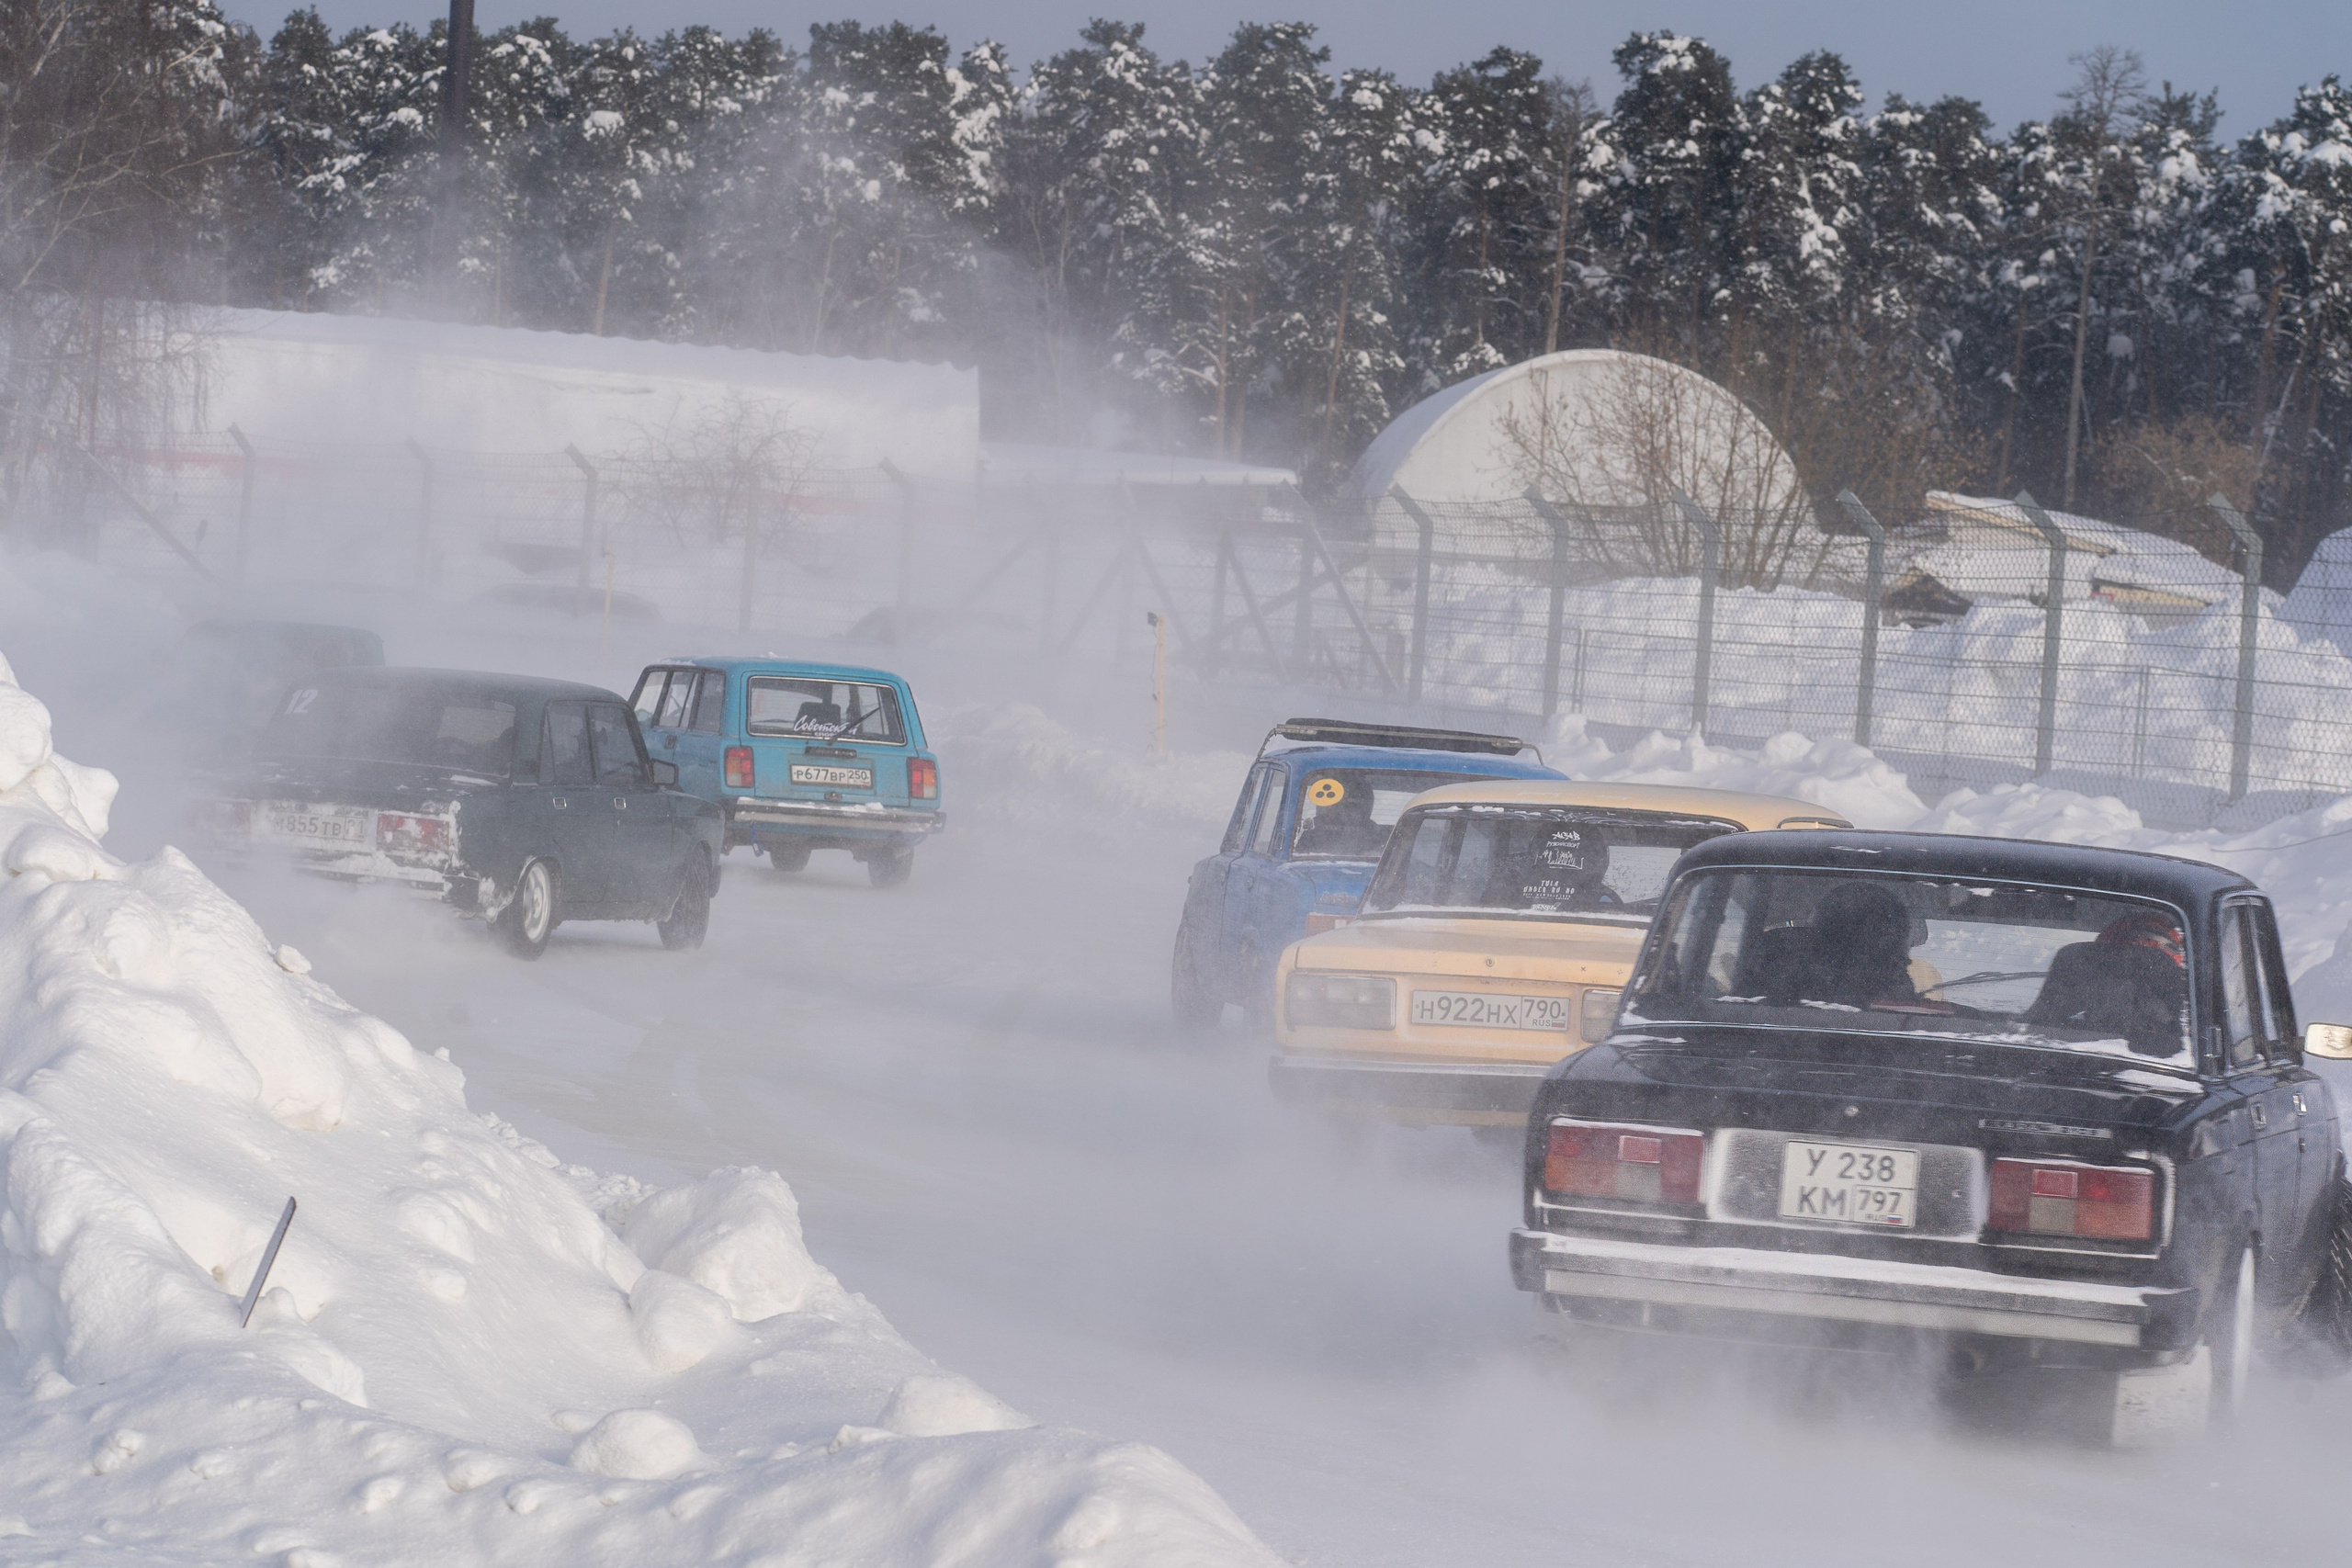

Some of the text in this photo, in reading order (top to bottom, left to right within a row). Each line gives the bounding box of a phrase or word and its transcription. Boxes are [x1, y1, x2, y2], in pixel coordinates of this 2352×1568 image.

[285, 689, 318, 714] 12
[1419, 995, 1563, 1024] Н922НХ 790
[1532, 1019, 1551, 1027] RUS
[1837, 1152, 1895, 1182] 238
[1797, 1185, 1901, 1216] КМ 797
